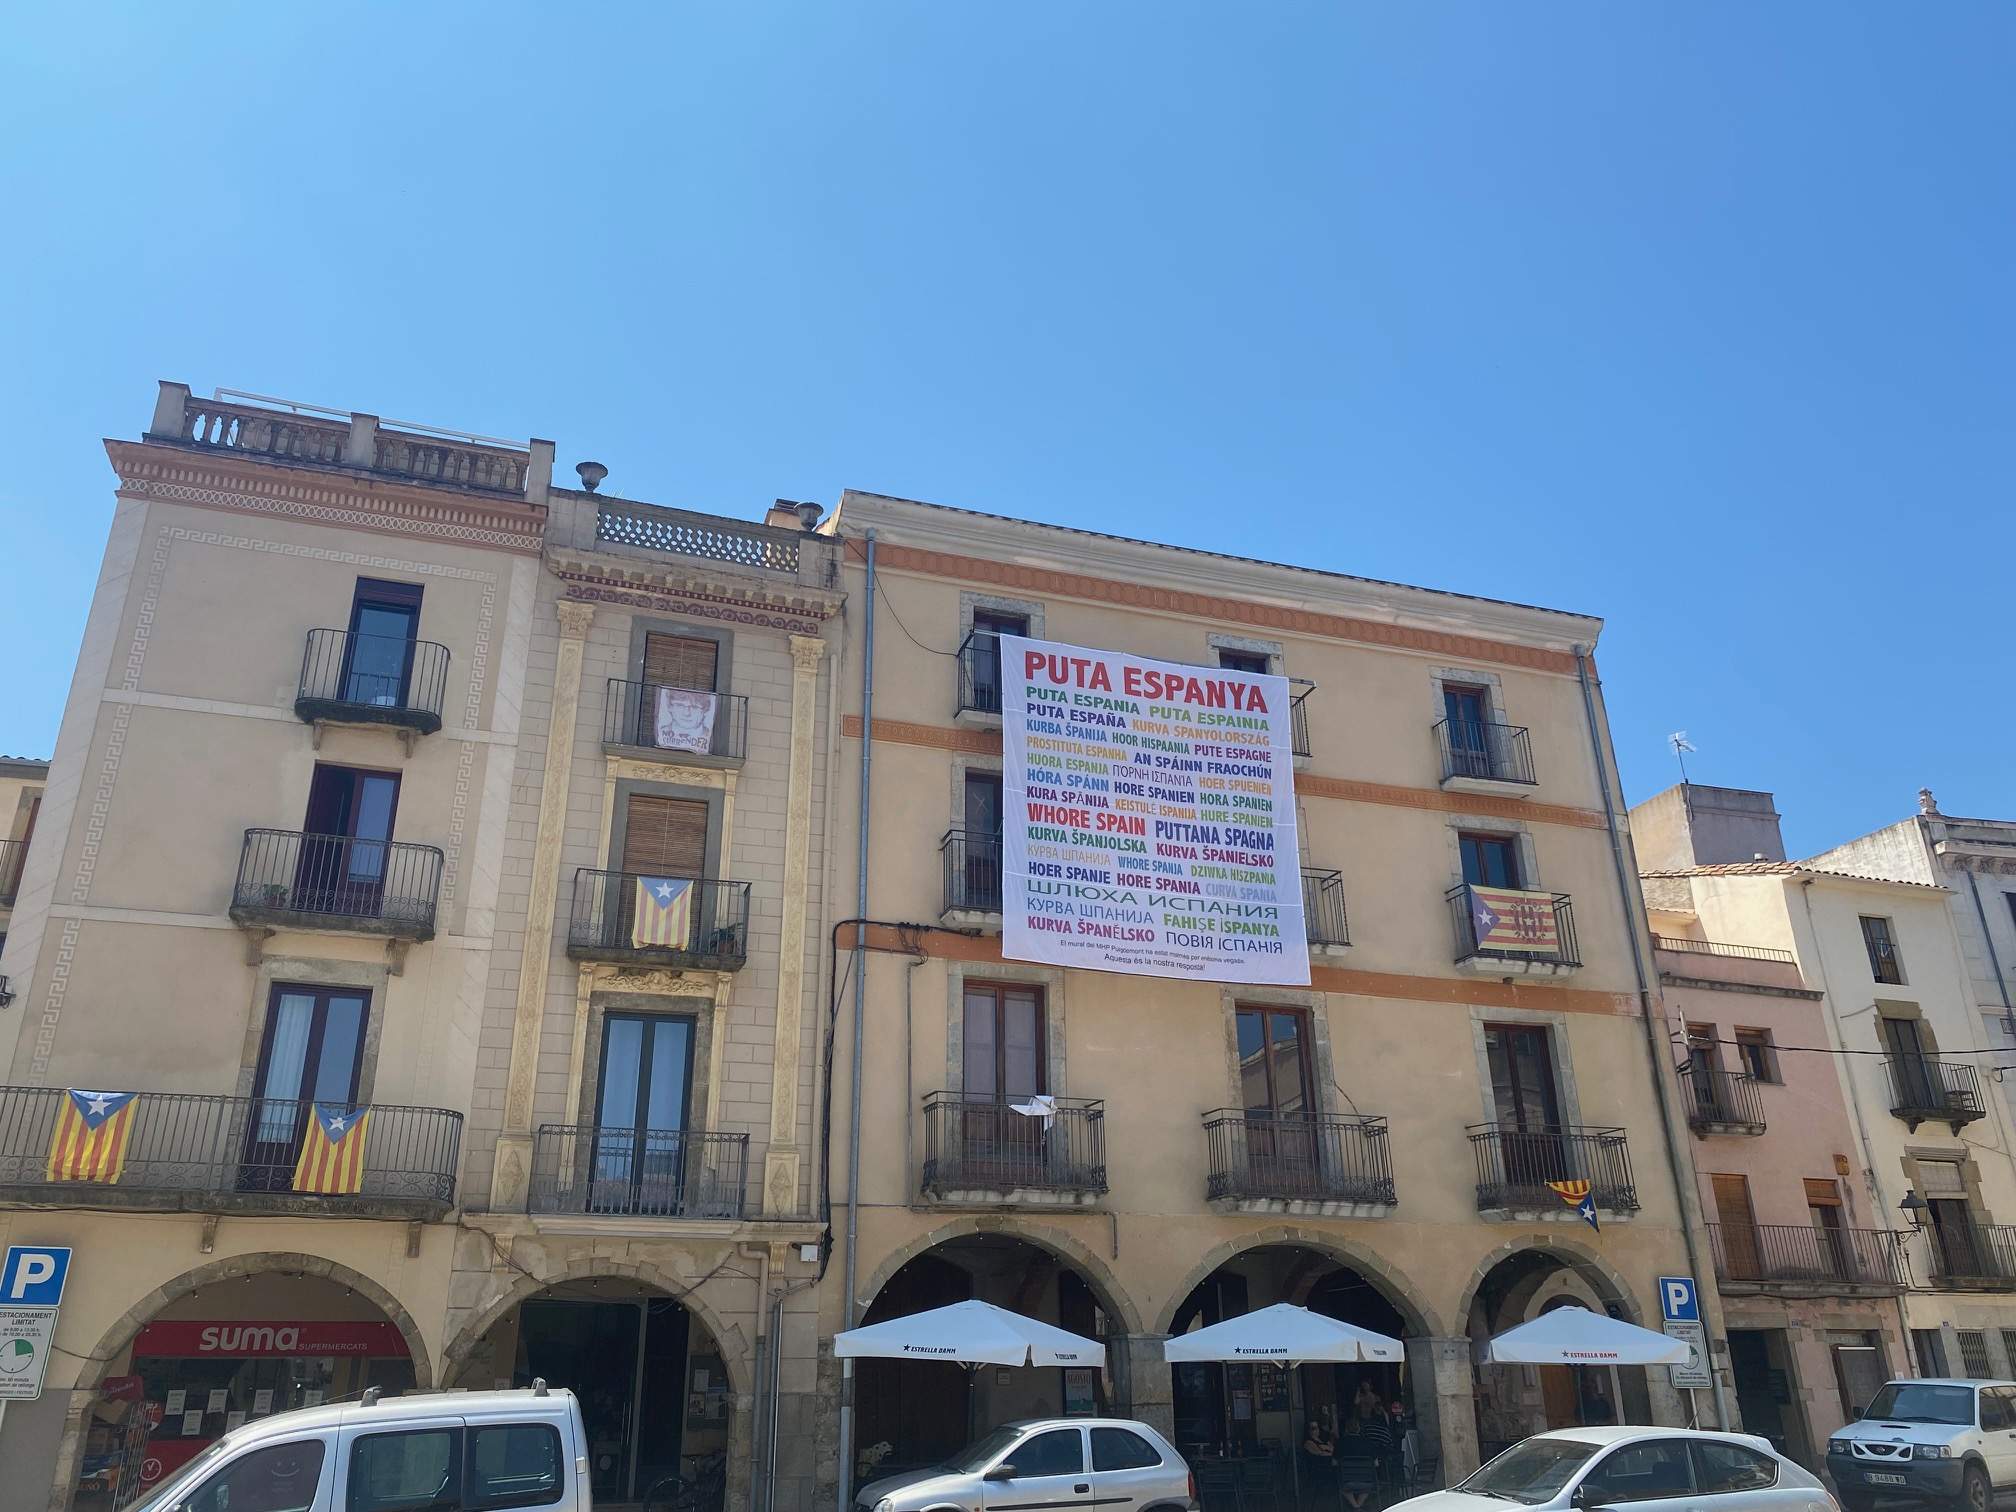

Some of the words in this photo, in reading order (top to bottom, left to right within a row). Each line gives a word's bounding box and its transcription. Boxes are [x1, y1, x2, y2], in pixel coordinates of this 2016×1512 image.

[1025, 650, 1112, 692] PUTA
[1123, 666, 1269, 714] ESPANYA
[1026, 686, 1068, 704] PUTA
[1074, 693, 1140, 715] ESPANIA
[1149, 705, 1192, 723] PUTA
[1197, 711, 1270, 731] ESPAINIA
[1026, 702, 1065, 719] PUTA
[1070, 709, 1127, 728] ESPAÑA
[1132, 719, 1170, 736] KURVA
[1173, 725, 1270, 747] SPANYOLORSZÁG
[1026, 718, 1062, 735] KURBA
[1112, 732, 1138, 747] HOOR
[1141, 736, 1190, 755] HISPAANIA
[1194, 744, 1222, 758] PUTE
[1226, 747, 1272, 763] ESPAGNE
[1027, 735, 1083, 755] PROSTITUTA
[1085, 744, 1127, 761] ESPANHA
[1134, 752, 1151, 766] AN
[1155, 755, 1203, 773] SPÁINN
[1207, 761, 1272, 780] FRAOCHÚN
[1027, 752, 1062, 769] HUORA
[1066, 758, 1109, 775] ESPANJA
[1027, 766, 1062, 786] HÓRA
[1067, 774, 1109, 792] SPÁNN
[1114, 781, 1145, 797] HORE
[1148, 786, 1195, 804] SPANIEN
[1200, 792, 1229, 807] HORA
[1232, 795, 1272, 812] SPANIEN
[1199, 776, 1226, 789] HOER
[1228, 779, 1272, 796] SPUENIEN
[1026, 785, 1057, 801] KURA
[1160, 805, 1197, 820] ISPANIJA
[1200, 809, 1229, 823] HURE
[1232, 812, 1273, 828] SPANIEN
[1027, 802, 1090, 829] WHORE
[1096, 812, 1146, 836] SPAIN
[1155, 820, 1221, 845] PUTTANA
[1224, 827, 1274, 851] SPAGNA
[1027, 826, 1068, 844] KURVA
[1072, 828, 1147, 854] ŠPANJOLSKA
[1156, 842, 1198, 860] KURVA
[1202, 845, 1274, 868] ŠPANIELSKO
[1028, 861, 1062, 878] HOER
[1066, 866, 1111, 884] SPANJE
[1117, 872, 1152, 889] HORE
[1155, 877, 1201, 895] SPANIA
[1205, 883, 1238, 898] CURVA
[1118, 856, 1150, 871] WHORE
[1191, 865, 1228, 880] DZIWKA
[1230, 868, 1276, 886] HISZPANIA
[1027, 879, 1138, 905] ШЛЮХА
[1148, 894, 1278, 919] ИСПАНИЯ
[1027, 897, 1075, 915] КУРВА
[1027, 915, 1072, 934] KURVA
[1077, 918, 1155, 942] ŠPANĚLSKO
[1163, 913, 1216, 933] FAHIŞE
[1104, 953, 1132, 965] Aquesta
[1144, 957, 1152, 965] la
[1153, 958, 1175, 968] nostra
[1166, 931, 1213, 949] ПОВІЯ
[1219, 937, 1283, 955] ІСПАНІЯ
[10, 1253, 56, 1299] P
[0, 1311, 53, 1319] ESTACIONAMENT
[1667, 1282, 1689, 1316] P
[199, 1326, 300, 1351] suma
[910, 1345, 938, 1354] ESTRELLA
[938, 1346, 956, 1355] DAMM
